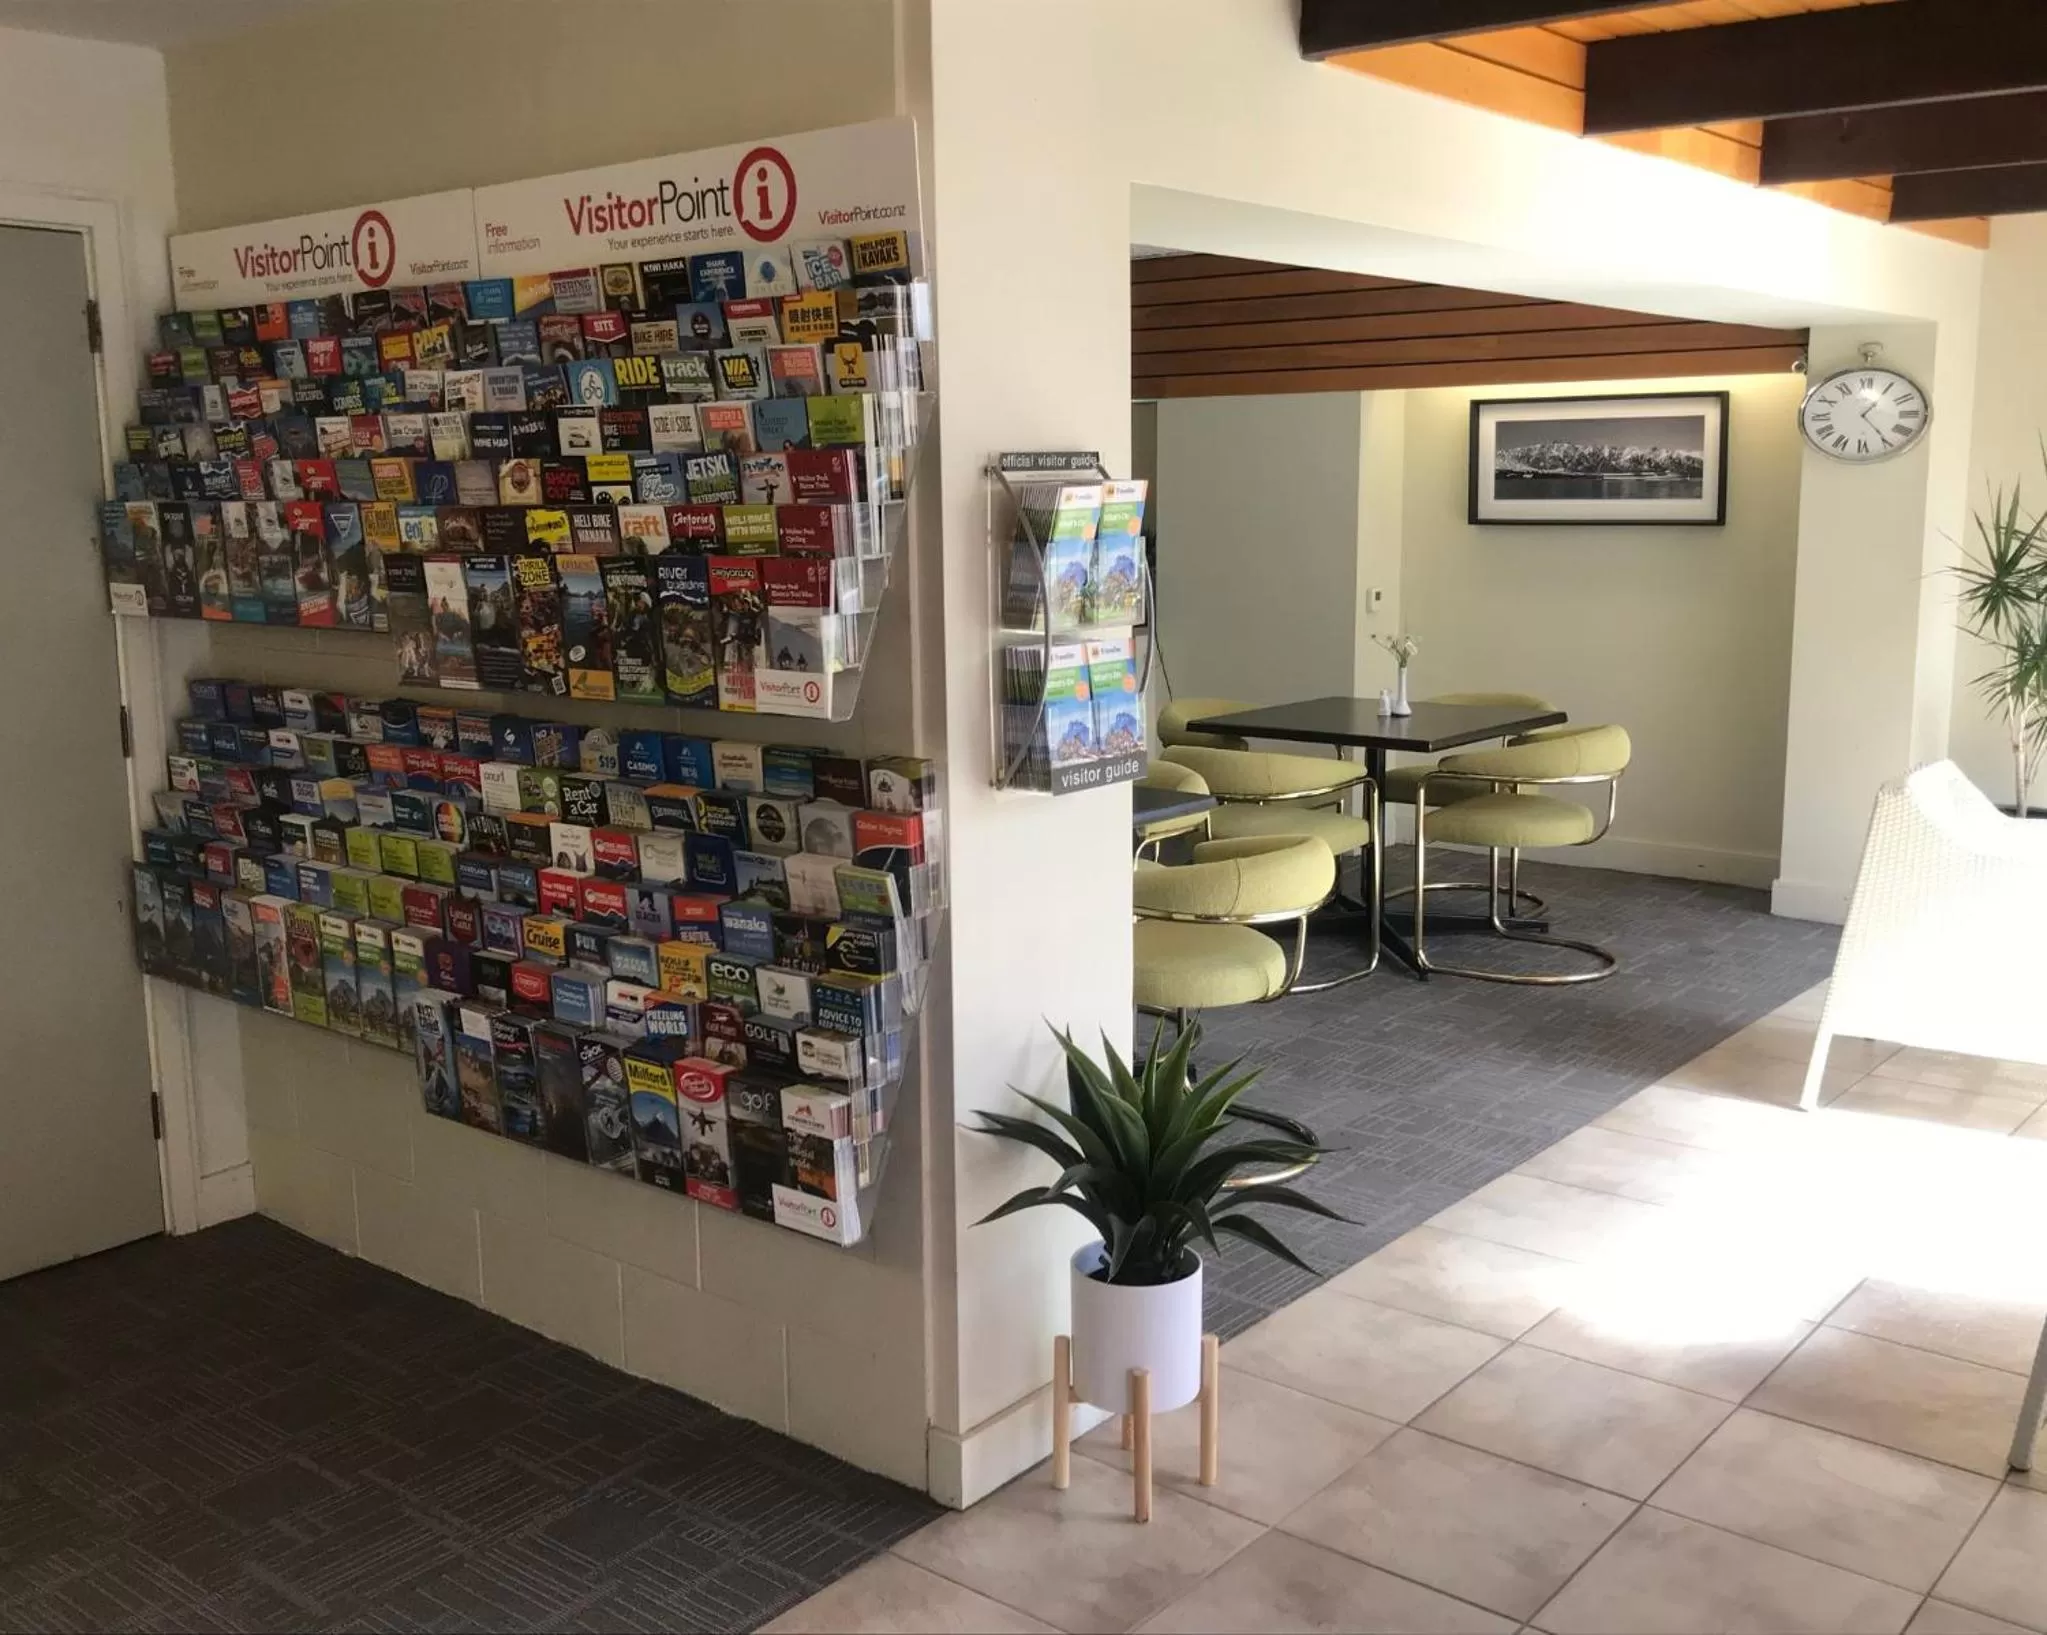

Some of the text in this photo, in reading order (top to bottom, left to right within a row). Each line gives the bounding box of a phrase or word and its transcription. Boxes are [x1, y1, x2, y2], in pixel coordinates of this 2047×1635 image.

[563, 176, 730, 236] VisitorPoint
[485, 223, 508, 238] Free
[608, 237, 628, 251] Your
[631, 232, 681, 250] experience
[682, 227, 708, 242] starts
[860, 236, 898, 250] MILFORD
[233, 232, 351, 280] VisitorPoint
[861, 248, 900, 267] KAYAKS
[806, 257, 834, 279] ICE
[813, 272, 843, 290] BAR
[613, 356, 660, 385] RIDE
[661, 359, 709, 378] track
[723, 358, 749, 376] VIA
[687, 455, 729, 480] JETSKI
[1002, 455, 1097, 469] official visitor guide
[624, 516, 660, 536] raft
[520, 558, 546, 572] THRILL
[522, 569, 550, 584] ZONE
[627, 760, 658, 773] CASINO
[1061, 759, 1140, 788] visitor guide
[563, 785, 591, 802] Rent
[579, 801, 599, 815] Car
[527, 931, 560, 950] Cruise
[710, 961, 750, 983] eco
[818, 1007, 862, 1028] ADVICE TO
[744, 1023, 777, 1043] GOLF
[628, 1063, 669, 1085] Milford
